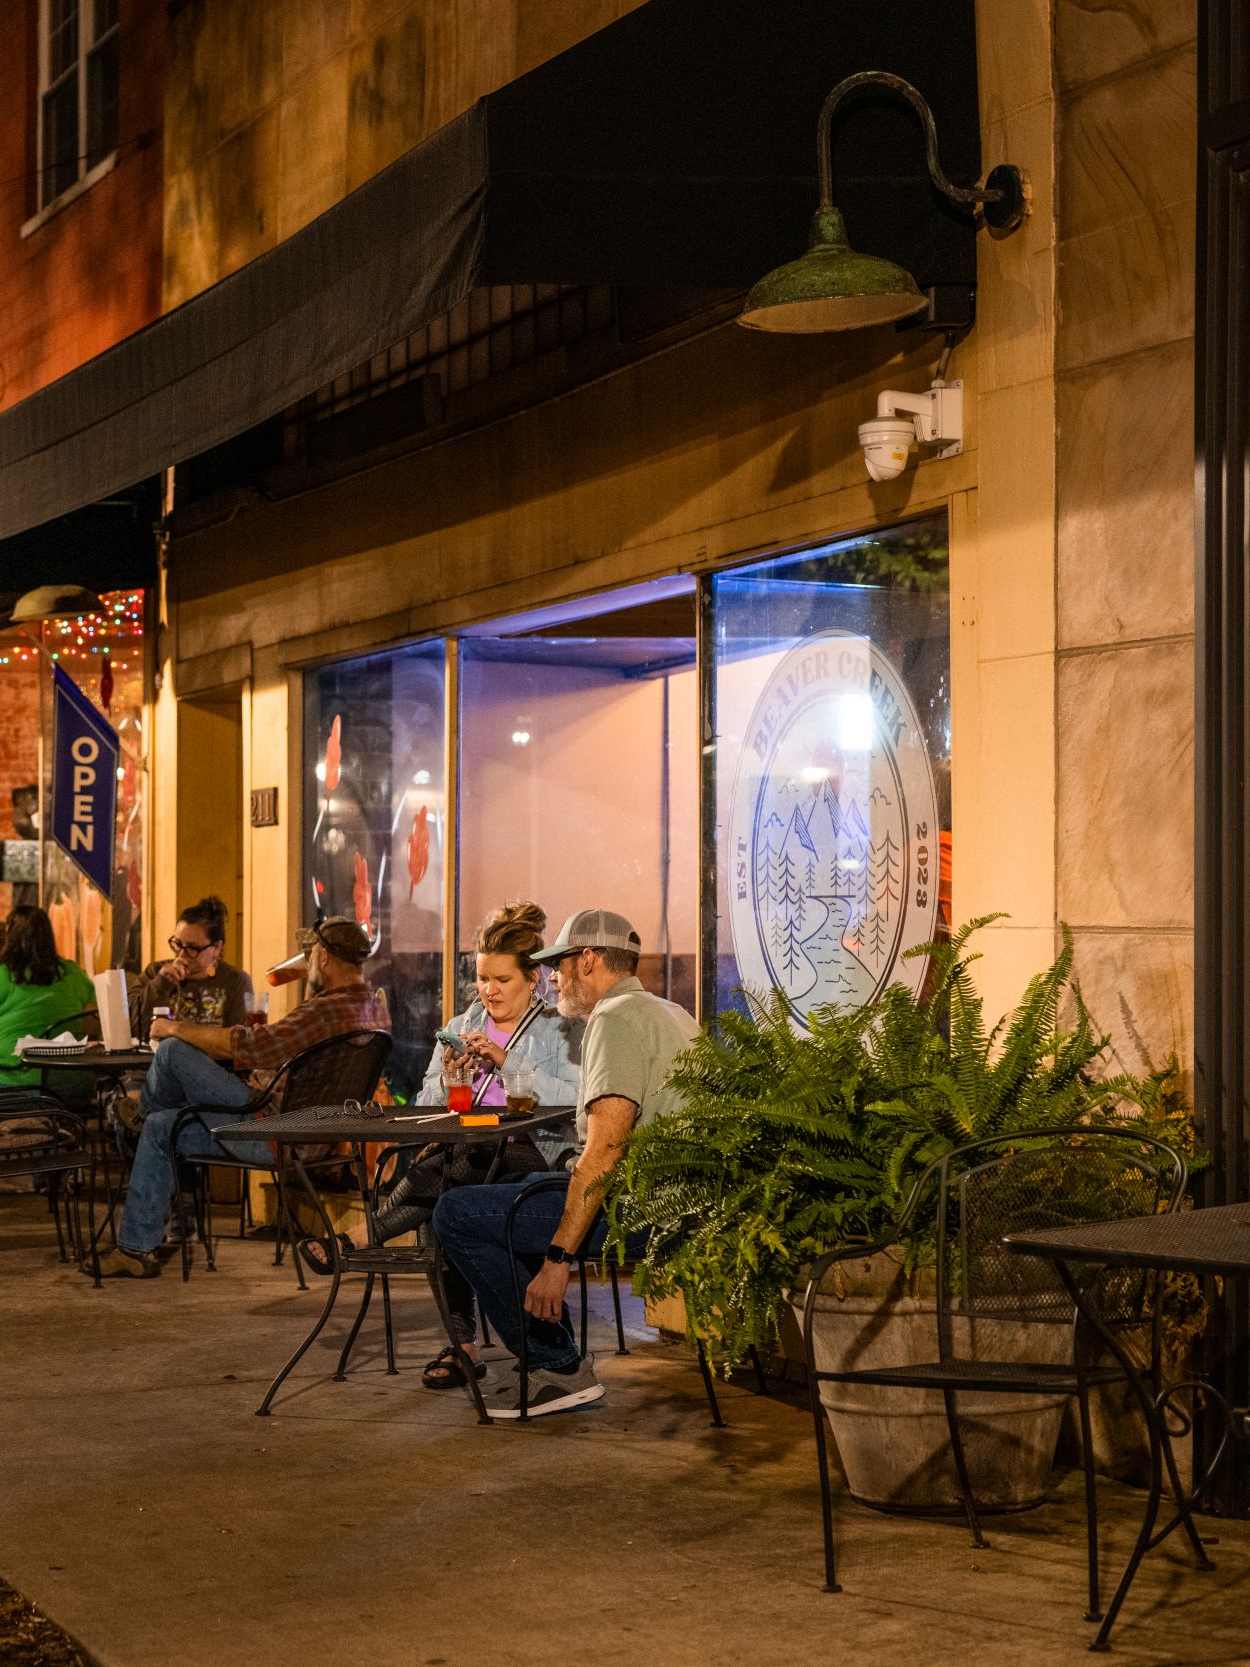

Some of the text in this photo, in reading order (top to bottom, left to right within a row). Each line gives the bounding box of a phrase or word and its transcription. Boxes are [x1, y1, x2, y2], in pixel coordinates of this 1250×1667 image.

[752, 650, 909, 763] BEAVER CREEK
[70, 736, 100, 852] OPEN
[737, 836, 748, 901] EST
[916, 821, 929, 909] 2023
